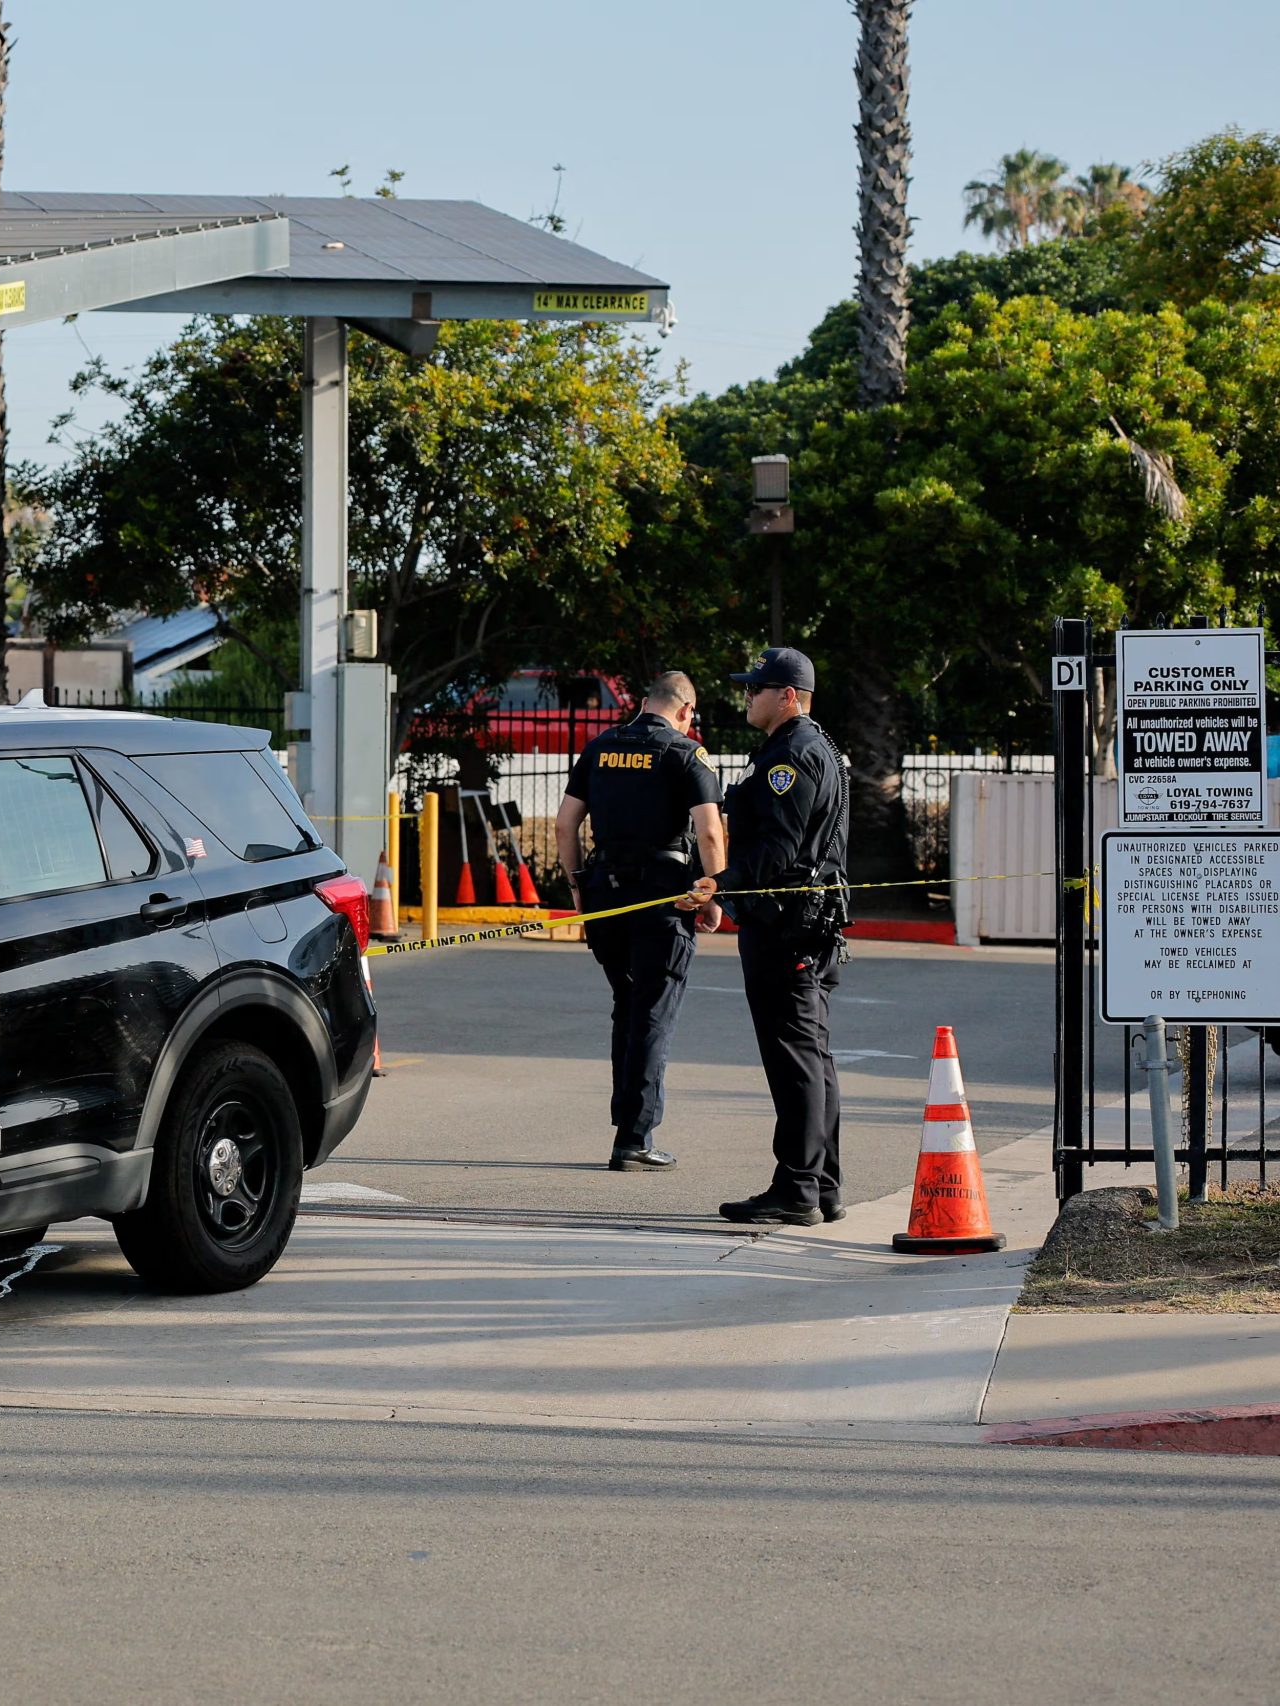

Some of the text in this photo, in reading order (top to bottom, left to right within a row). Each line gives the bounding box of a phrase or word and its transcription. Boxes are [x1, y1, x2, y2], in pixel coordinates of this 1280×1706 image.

[537, 294, 645, 310] 14' MAX CLEARANCE
[1057, 661, 1083, 686] D1
[1148, 667, 1235, 678] CUSTOMER
[1134, 680, 1249, 692] PARKING ONLY
[1128, 698, 1257, 708] OPEN PUBLIC PARKING PROHIBITED
[1127, 717, 1258, 729] All unauthorized vehicles will be
[1133, 731, 1251, 752] TOWED AWAY
[598, 752, 652, 769] POLICE
[1134, 757, 1251, 769] at vehicle owner's expense.
[1167, 788, 1253, 797] LOYAL TOWING
[1170, 800, 1250, 810] 619-794-7637
[1125, 814, 1169, 822] JUMPSTART
[1117, 843, 1279, 851] UNAUTHORIZED VEHICLES PARKED
[1131, 856, 1265, 864] IN DESIGNATED ACCESSIBLE
[1139, 868, 1257, 876] SPACES NOT DISPLAYING
[1125, 880, 1271, 888] DISTINGUISHING PLACARDS OR
[1118, 893, 1279, 901] SPECIAL LICENSE PLATES ISSUED
[1118, 905, 1278, 913] FOR PERSONS WITH DISABILITIES
[1146, 917, 1251, 925] WILL BE TOWED AWAY
[386, 922, 544, 954] POLICE LINE DO NOT CROSS
[1134, 929, 1262, 938] AT THE OWNER'S EXPENSE
[1160, 948, 1237, 956] TOWED VEHICLES
[1144, 960, 1252, 968] MAY BE RECLAIMED AT
[1151, 991, 1246, 999] OR BY TELEPHONING
